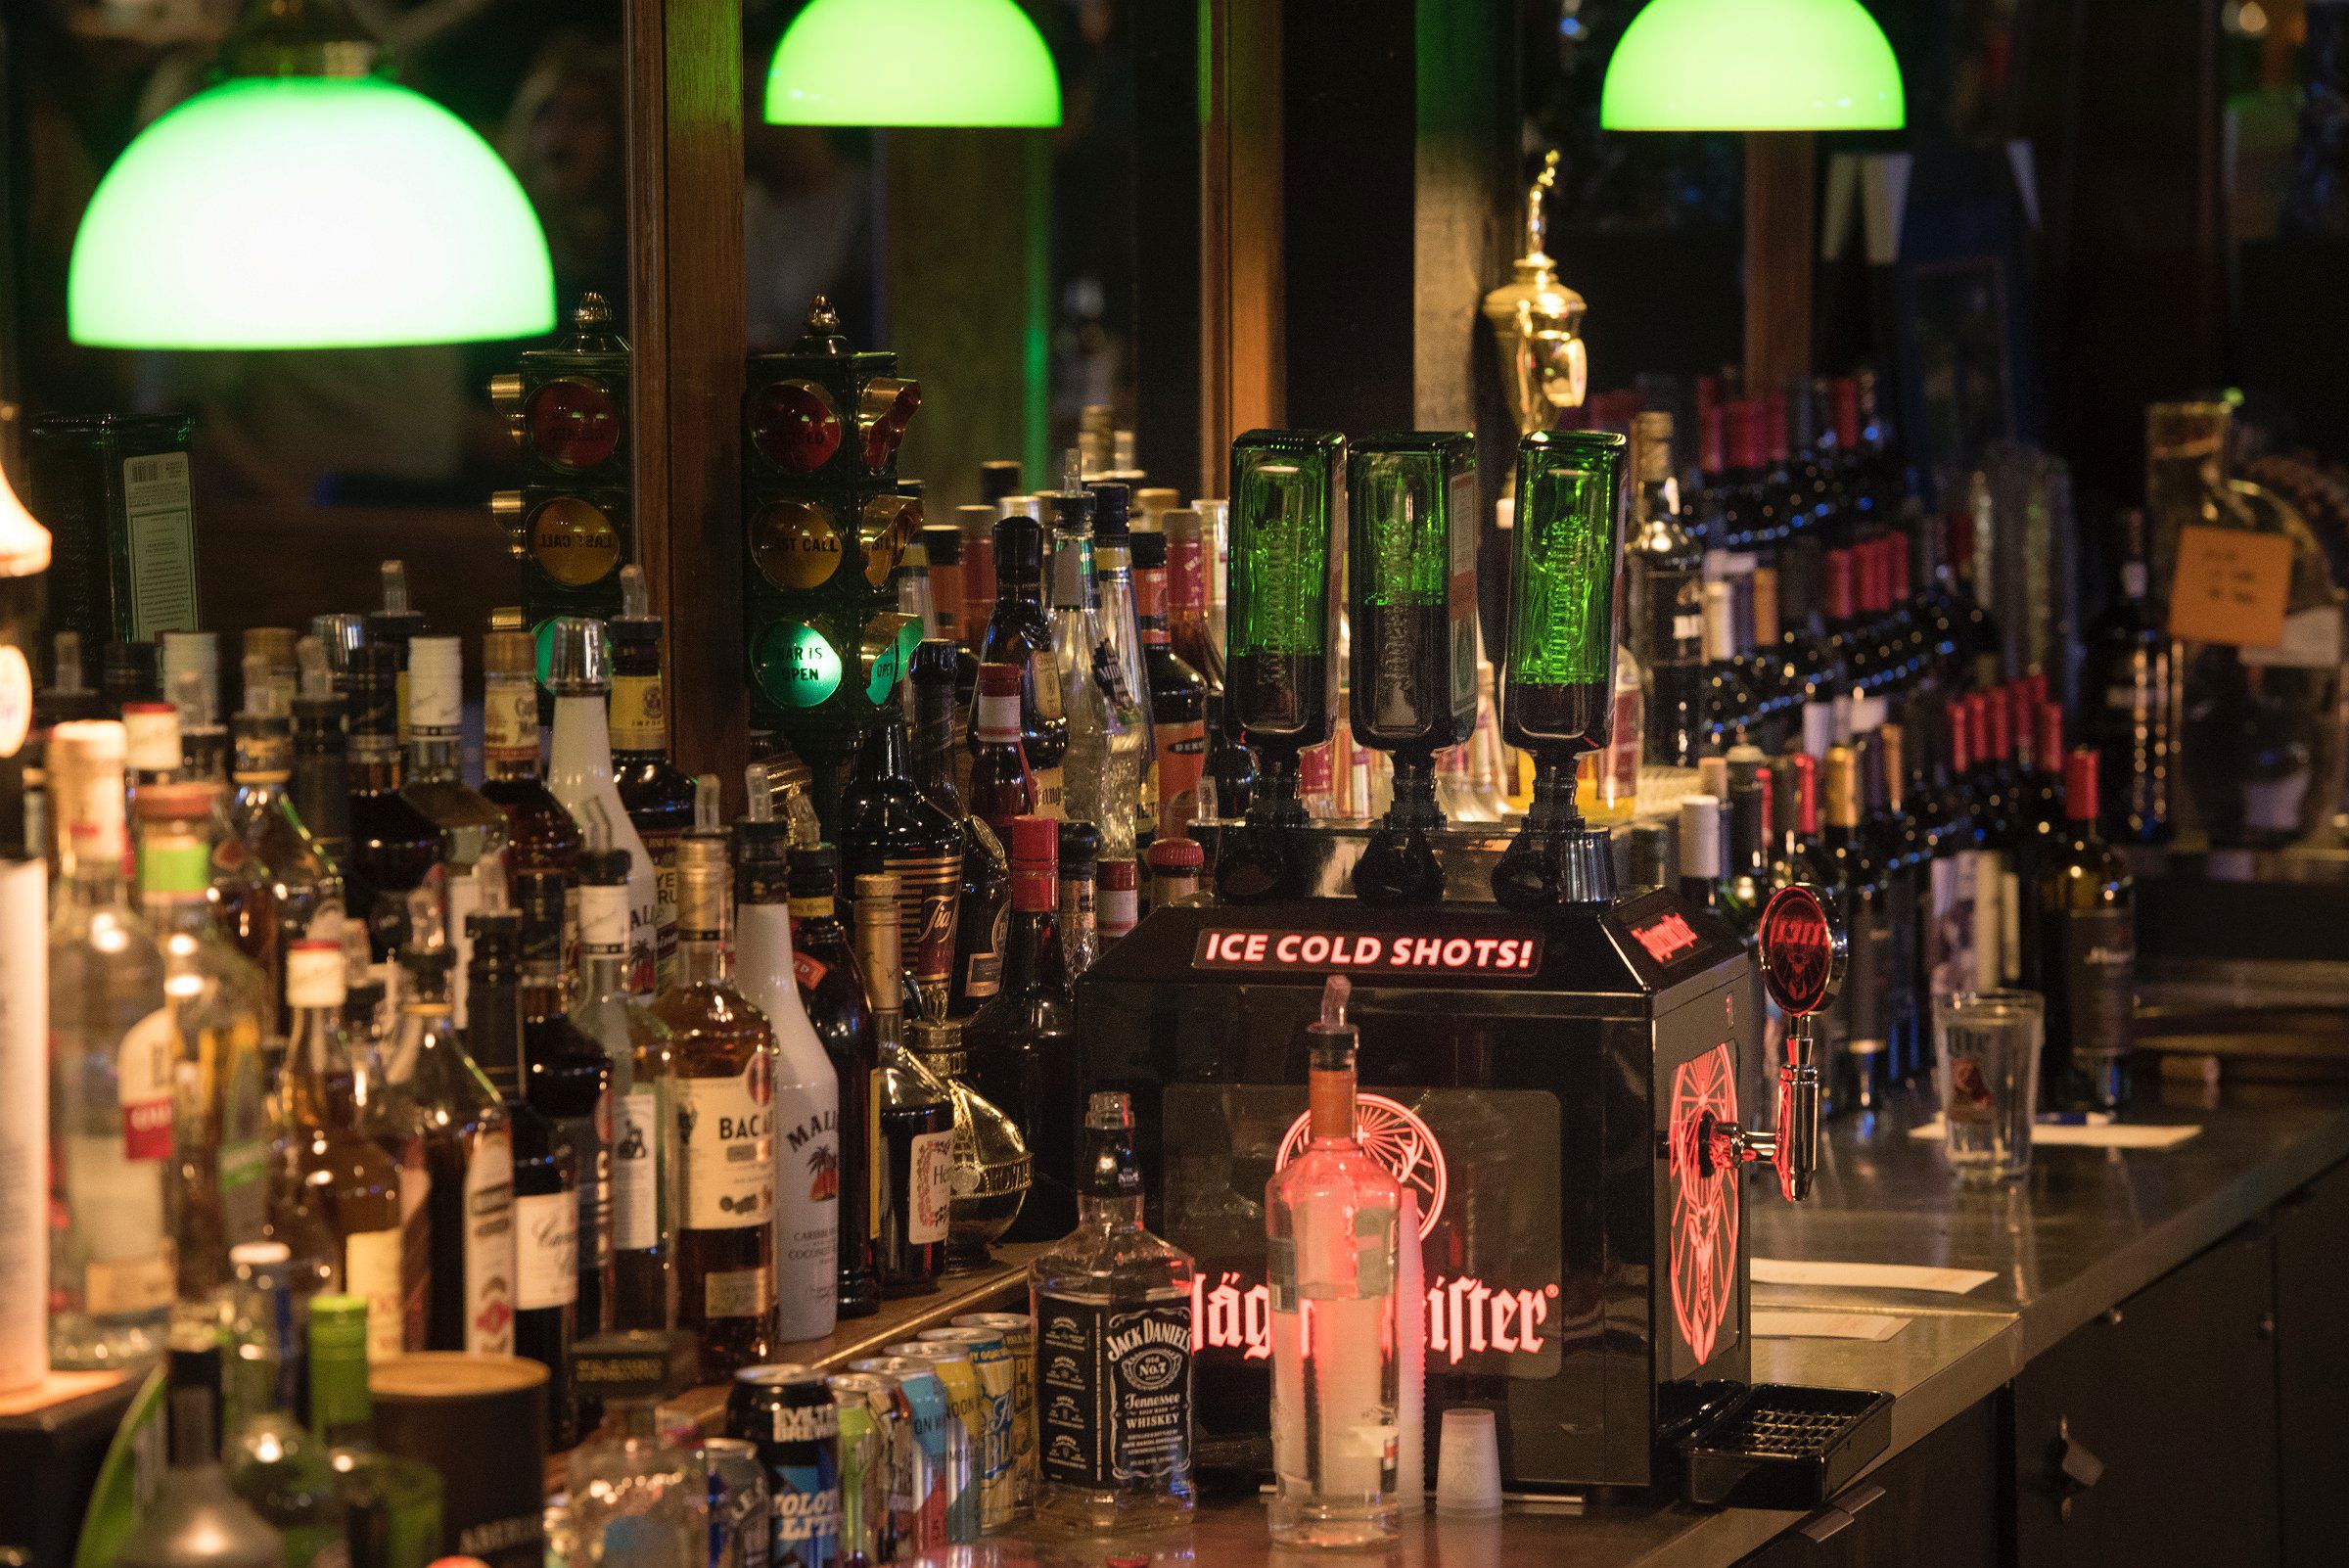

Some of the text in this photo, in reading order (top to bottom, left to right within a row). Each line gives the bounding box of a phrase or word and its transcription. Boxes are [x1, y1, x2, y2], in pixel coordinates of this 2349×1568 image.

[802, 538, 840, 554] CALL
[808, 646, 824, 661] IS
[1206, 933, 1534, 968] ICE COLD SHOTS!
[1106, 1324, 1143, 1361] JACK
[1138, 1361, 1167, 1376] No.7
[1125, 1393, 1180, 1409] Tennessee
[1126, 1412, 1180, 1430] WHISKEY
